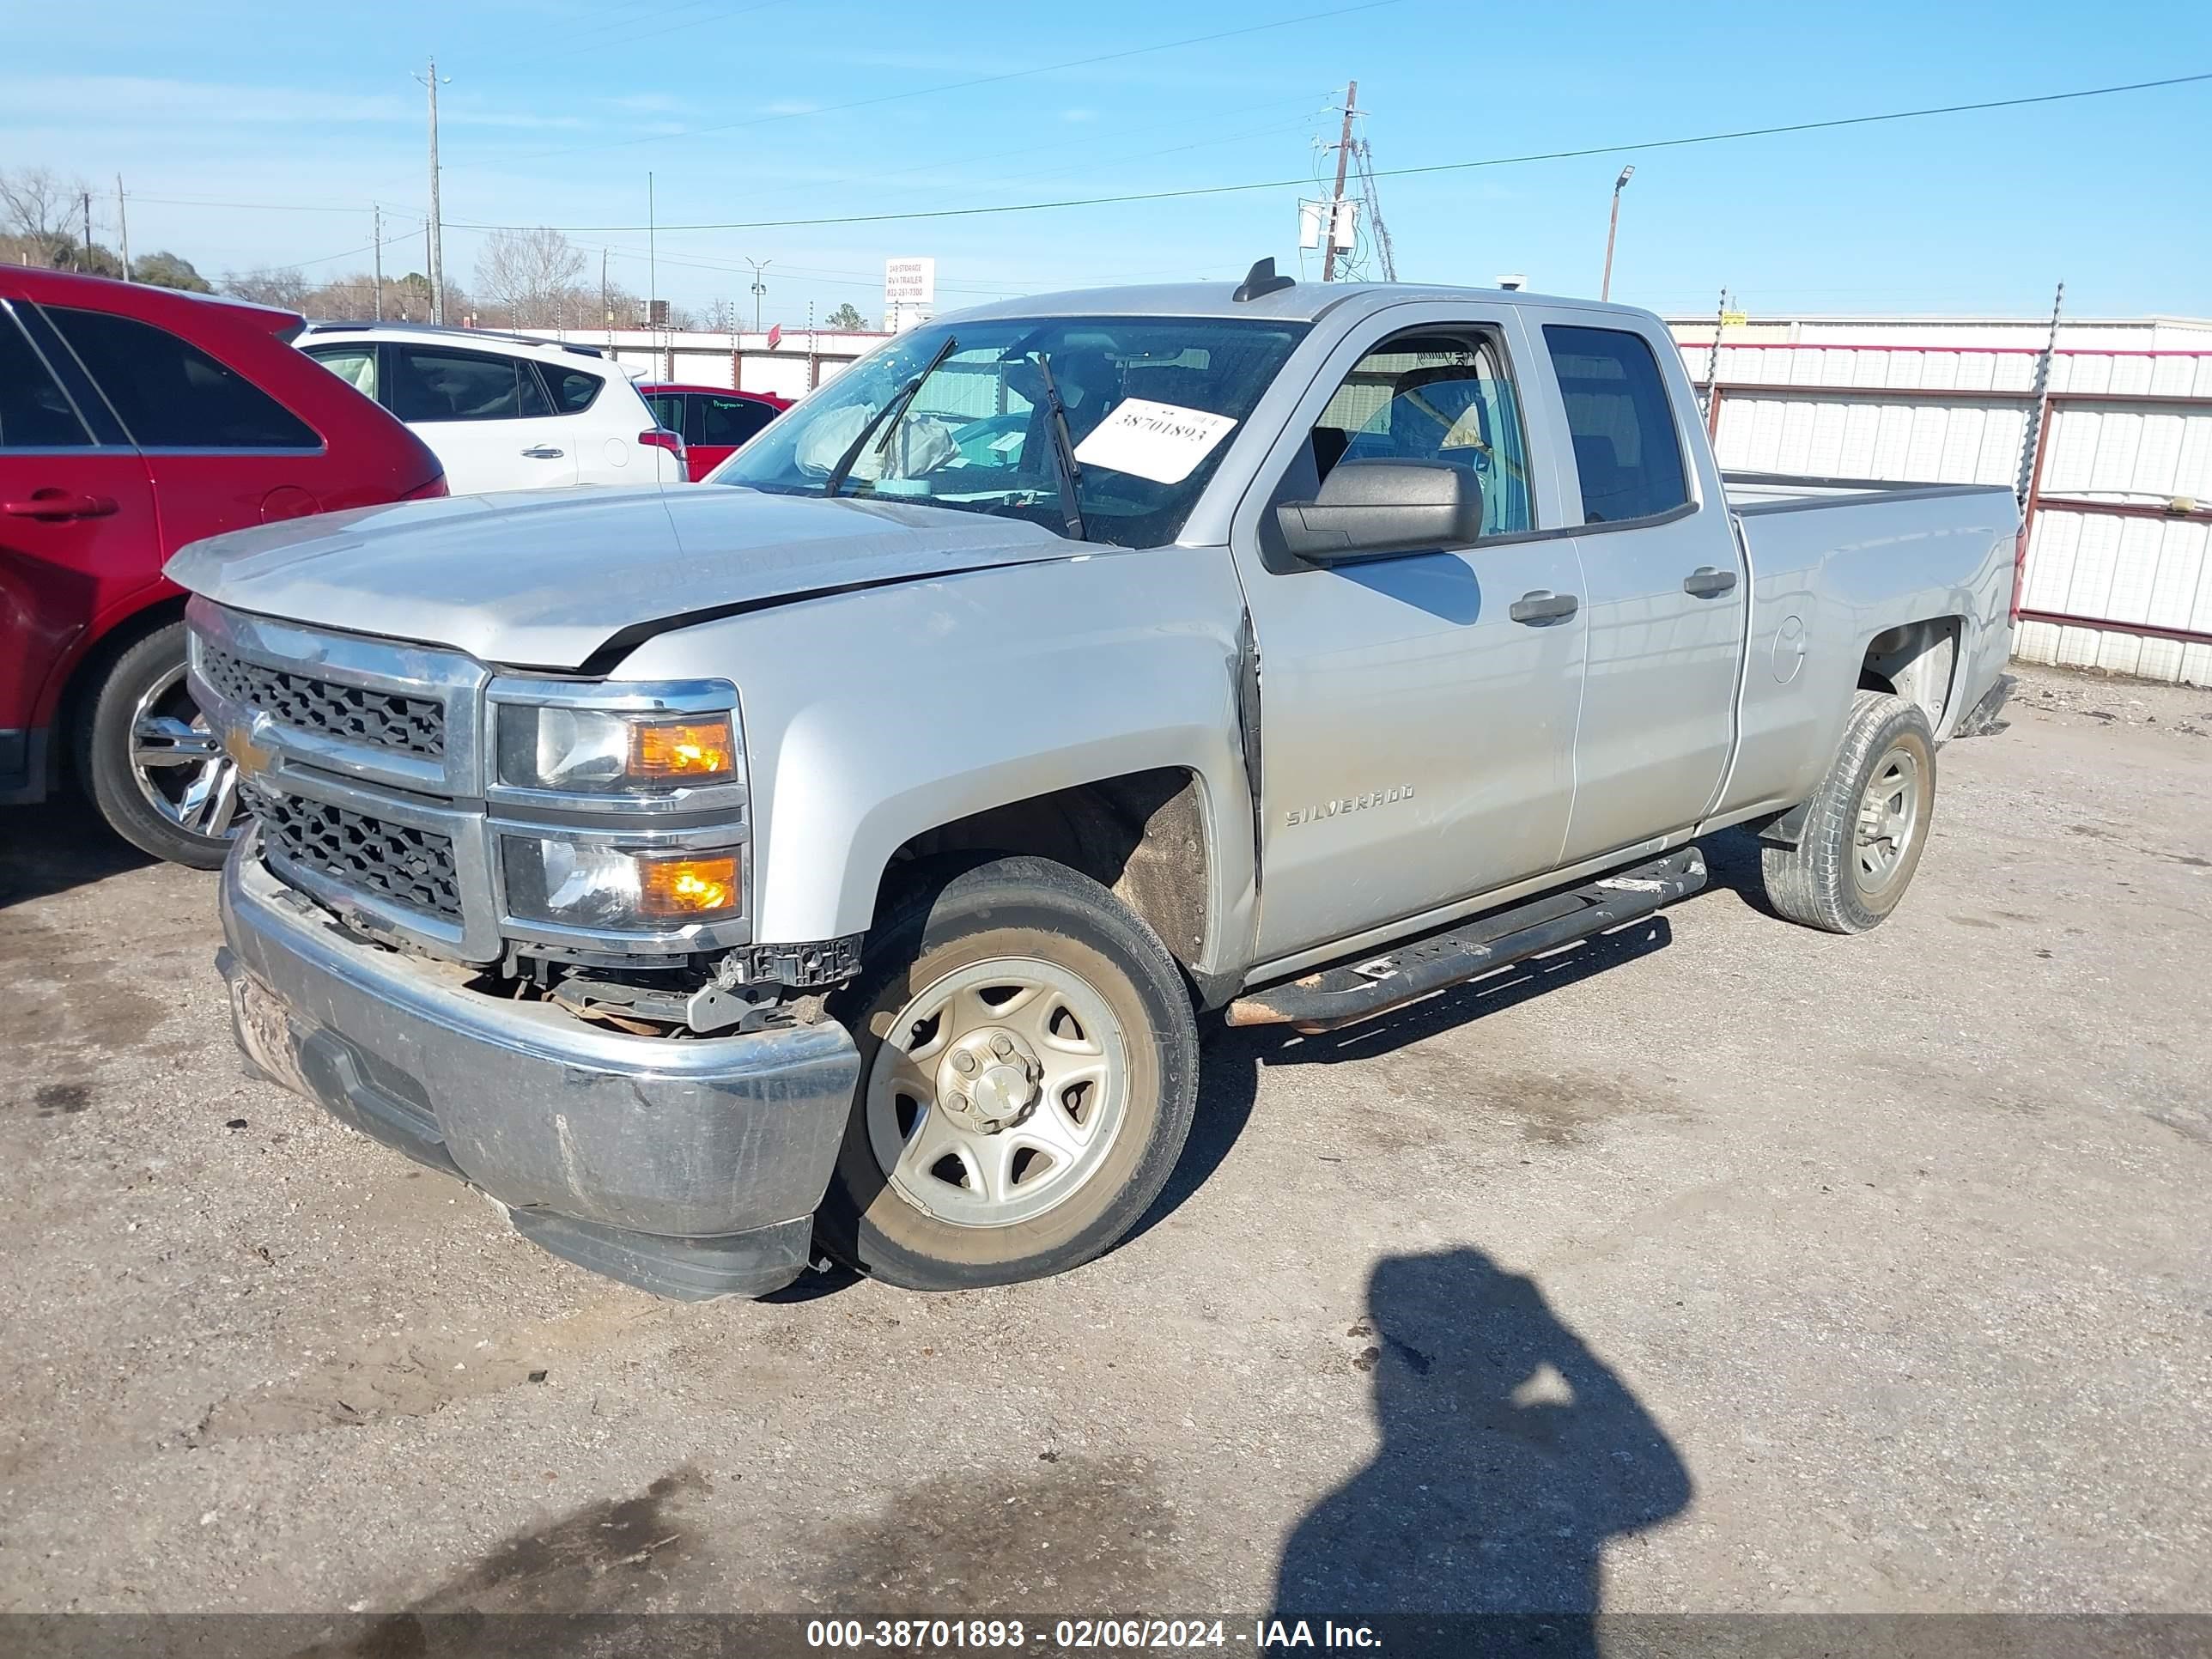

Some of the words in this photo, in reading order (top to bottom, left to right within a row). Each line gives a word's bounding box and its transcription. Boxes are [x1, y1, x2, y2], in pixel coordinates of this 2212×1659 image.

[899, 276, 922, 284] TRAILER
[1115, 414, 1207, 441] 38701893
[1285, 784, 1414, 827] SILVERADO
